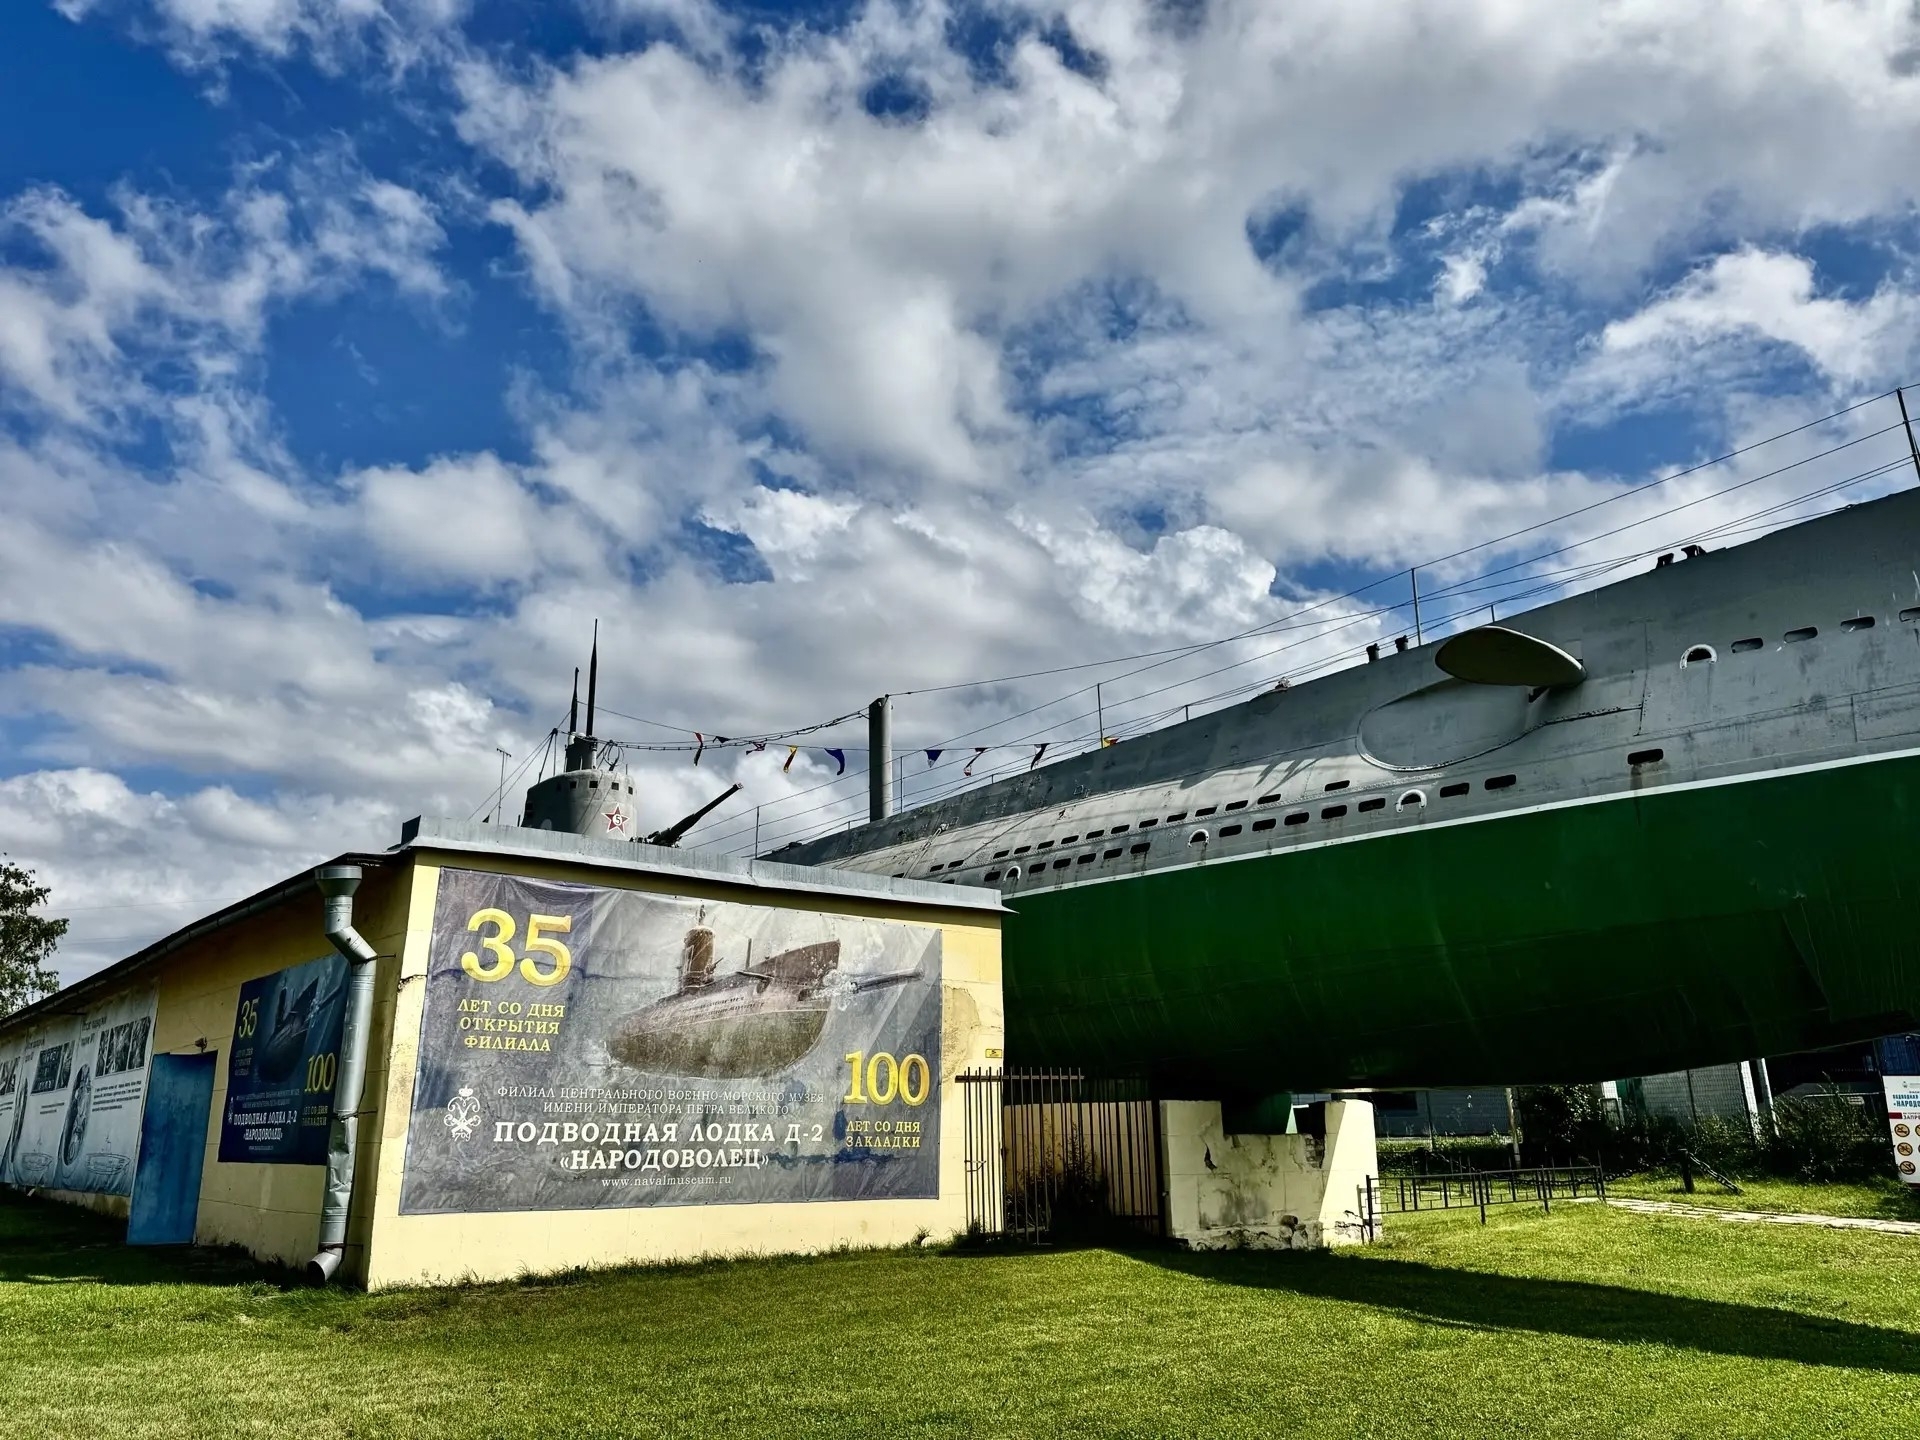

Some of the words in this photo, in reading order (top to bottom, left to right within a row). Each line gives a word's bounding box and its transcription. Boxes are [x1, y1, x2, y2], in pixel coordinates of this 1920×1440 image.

[461, 907, 572, 987] 35
[238, 996, 260, 1038] 35
[457, 998, 491, 1012] ЛЕТ
[498, 1001, 521, 1015] СО
[527, 1003, 565, 1019] ДНЯ
[460, 1016, 560, 1035] ОТКРЫТИЯ
[464, 1035, 551, 1052] ФИЛИАЛА
[304, 1052, 336, 1092] 100
[843, 1050, 930, 1106] 100
[497, 1086, 555, 1098] ФИЛИАЛ
[560, 1087, 663, 1101] ЦЕНТРАЛЬНОГО
[668, 1089, 785, 1102] ВОЕННО-МОРСКОГО
[789, 1092, 824, 1103] МУЗЕЯ
[543, 1102, 592, 1113] ИМЕНИ
[598, 1103, 682, 1115] ИМПЕРАТОРА
[687, 1104, 725, 1115] ПЕТРА
[729, 1105, 789, 1115] ВЕЛИКОГО
[233, 1112, 267, 1125] ПОДВОДНАЯ
[846, 1120, 870, 1132] ЛЕТ
[874, 1121, 891, 1132] СО
[894, 1121, 921, 1134] ДНЯ
[493, 1121, 678, 1145] ПОДВОДНАЯ
[690, 1123, 775, 1145] ЛОДКА
[784, 1123, 824, 1144] Д-2
[845, 1135, 921, 1149] ЗАКЛАДКИ
[559, 1148, 769, 1172] «НАРОДОВОЛЕЦ»
[601, 1175, 732, 1187] www.navalmuseum.ru
